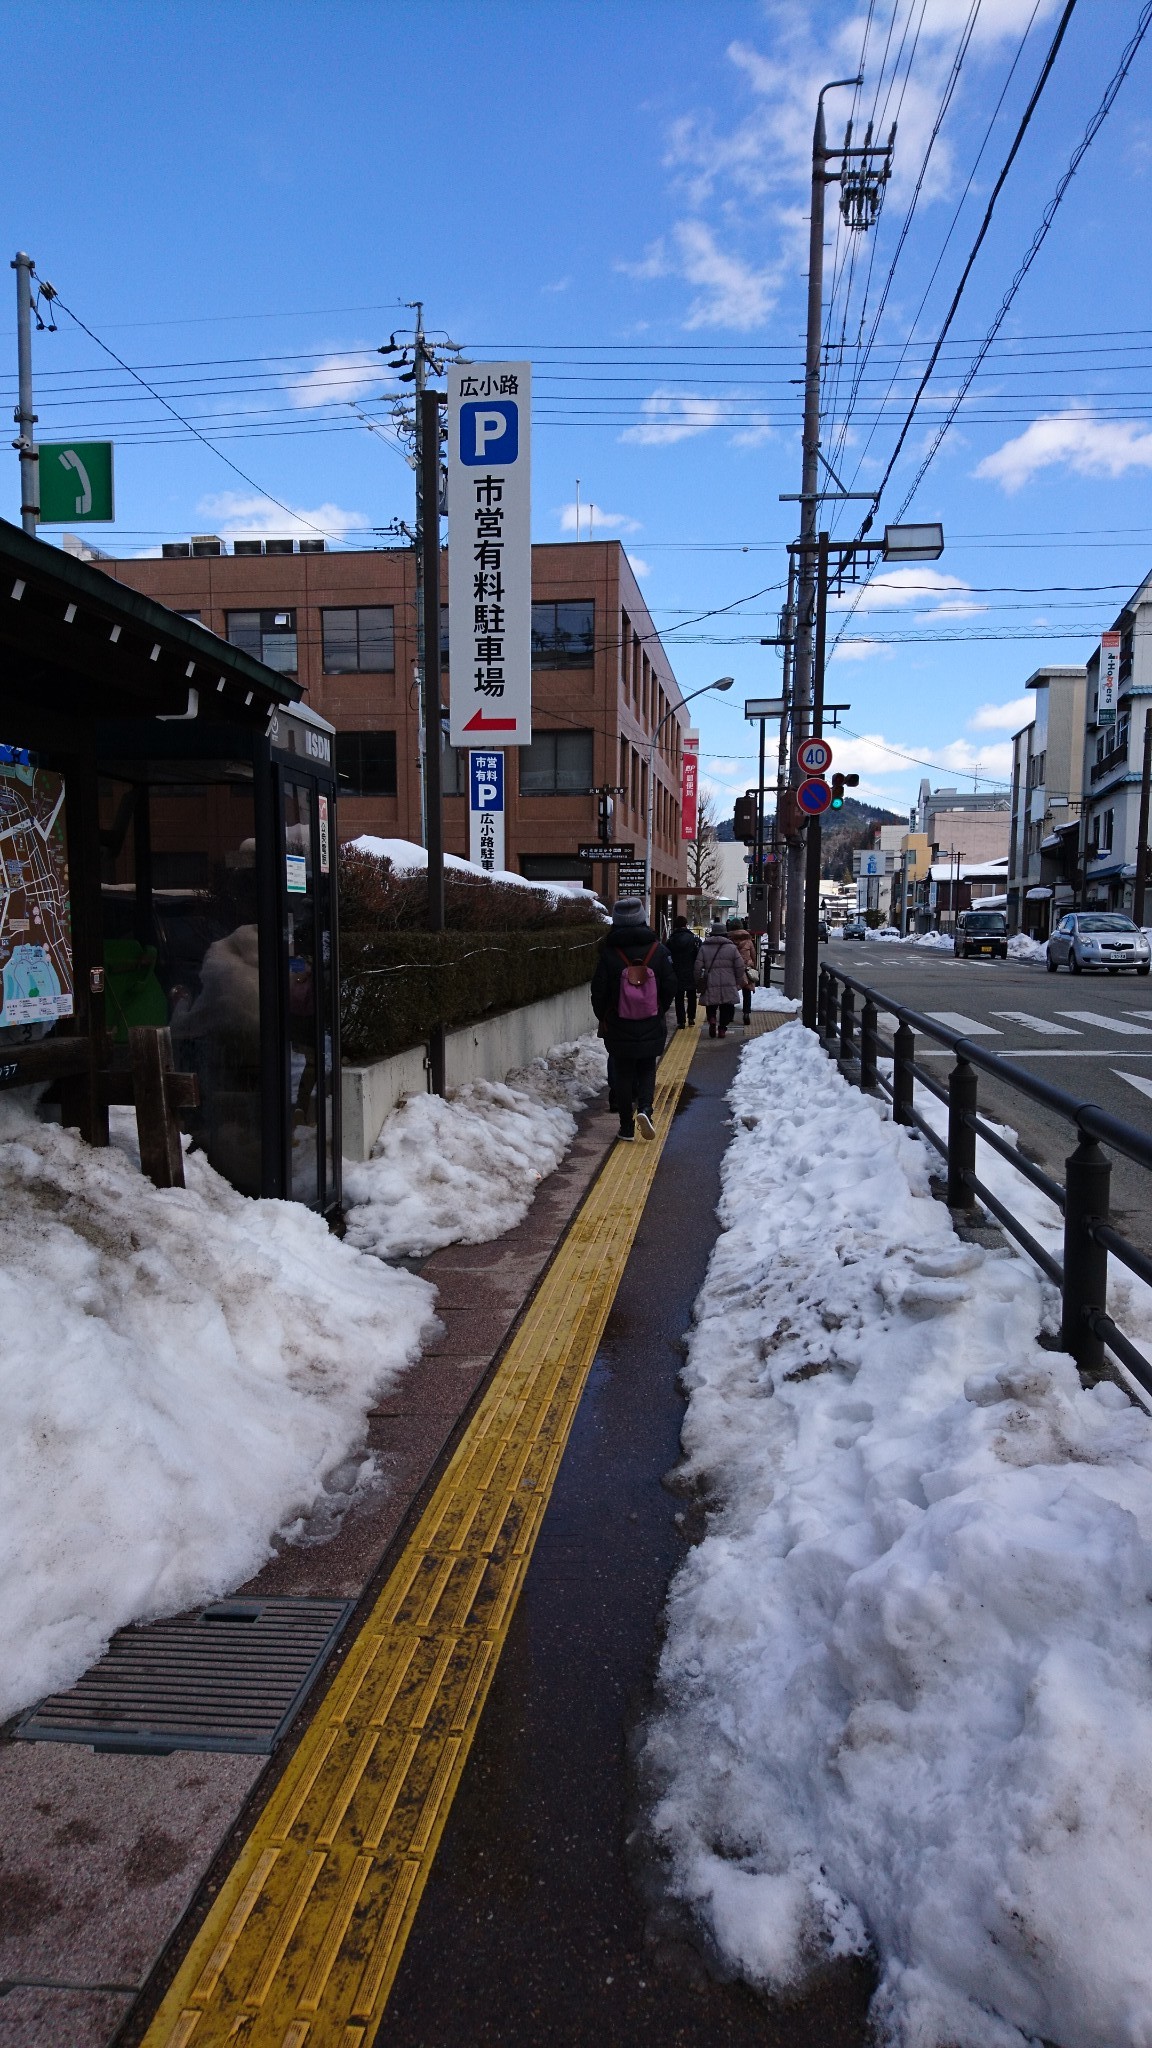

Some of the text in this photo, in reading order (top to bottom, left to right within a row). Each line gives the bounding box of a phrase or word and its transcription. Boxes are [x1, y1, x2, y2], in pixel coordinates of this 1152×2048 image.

[460, 374, 519, 397] 広小路
[474, 411, 507, 456] P
[473, 474, 506, 698] 市営有料駐車場
[305, 730, 331, 762] ISDN
[805, 748, 825, 765] 40
[475, 756, 498, 769] 市営
[475, 769, 498, 782] 有料
[478, 783, 498, 808] P
